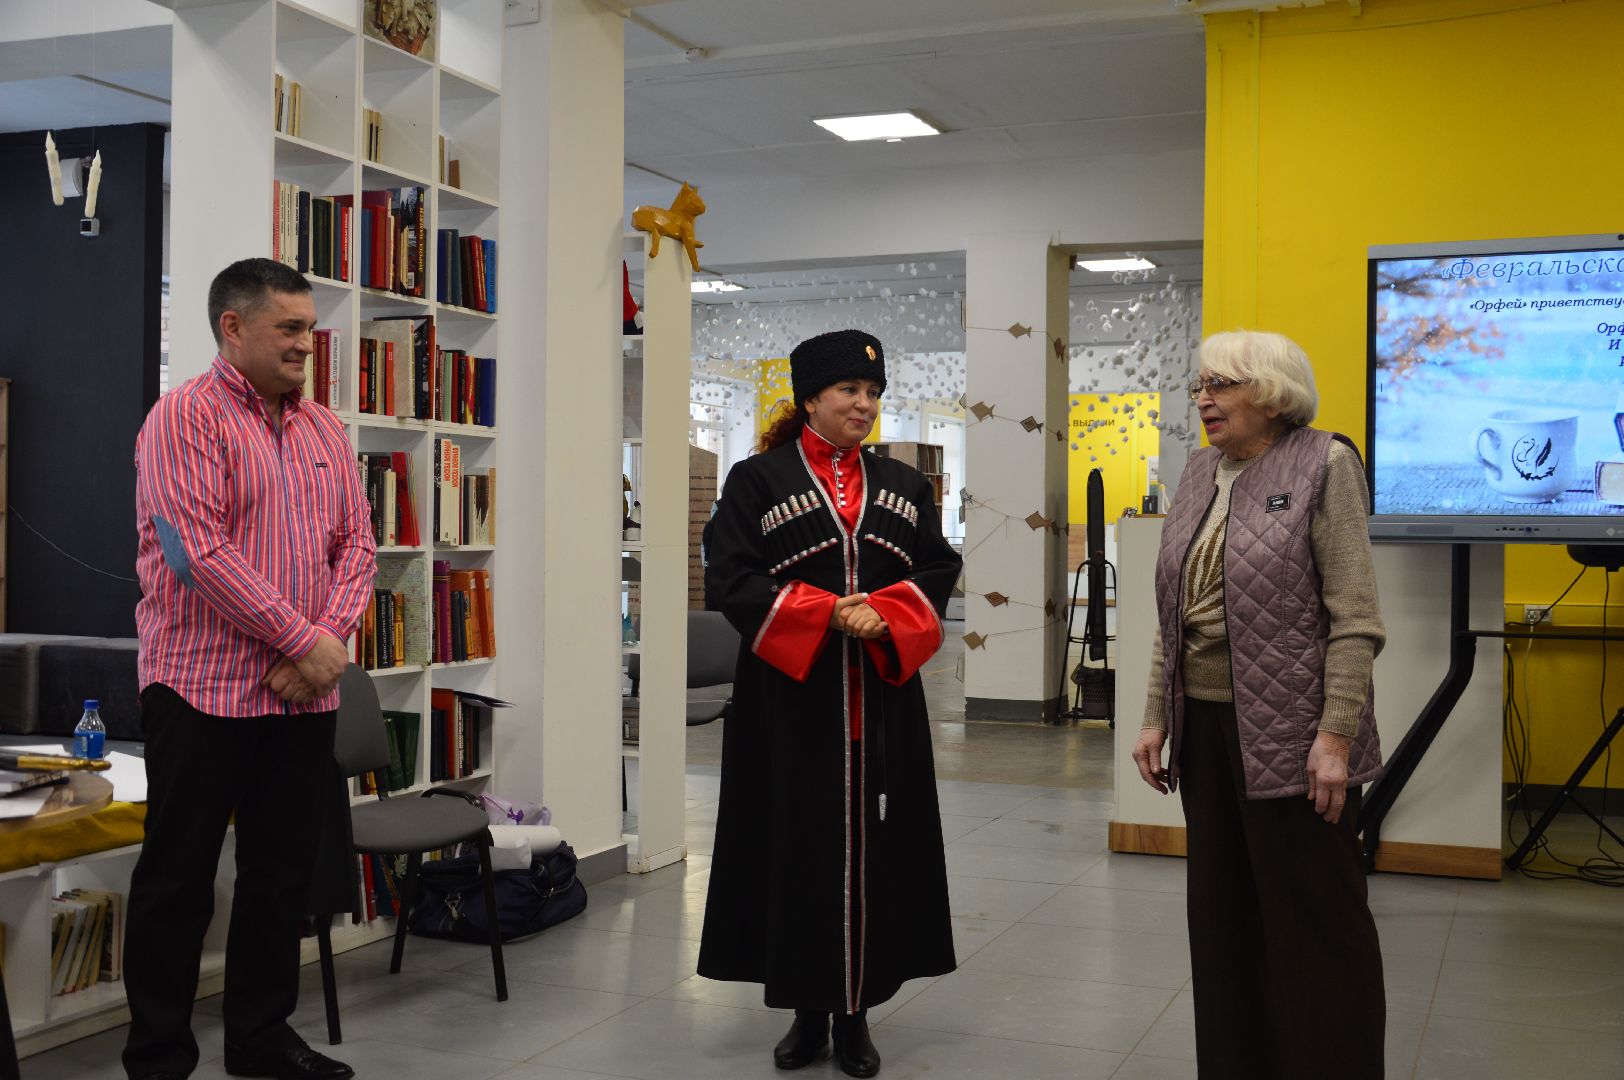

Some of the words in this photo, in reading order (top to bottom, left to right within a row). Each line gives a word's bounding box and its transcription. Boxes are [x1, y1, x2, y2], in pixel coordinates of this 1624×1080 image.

[1470, 299, 1527, 312] «Орфей»
[1531, 298, 1624, 310] приветству
[1608, 338, 1621, 351] И
